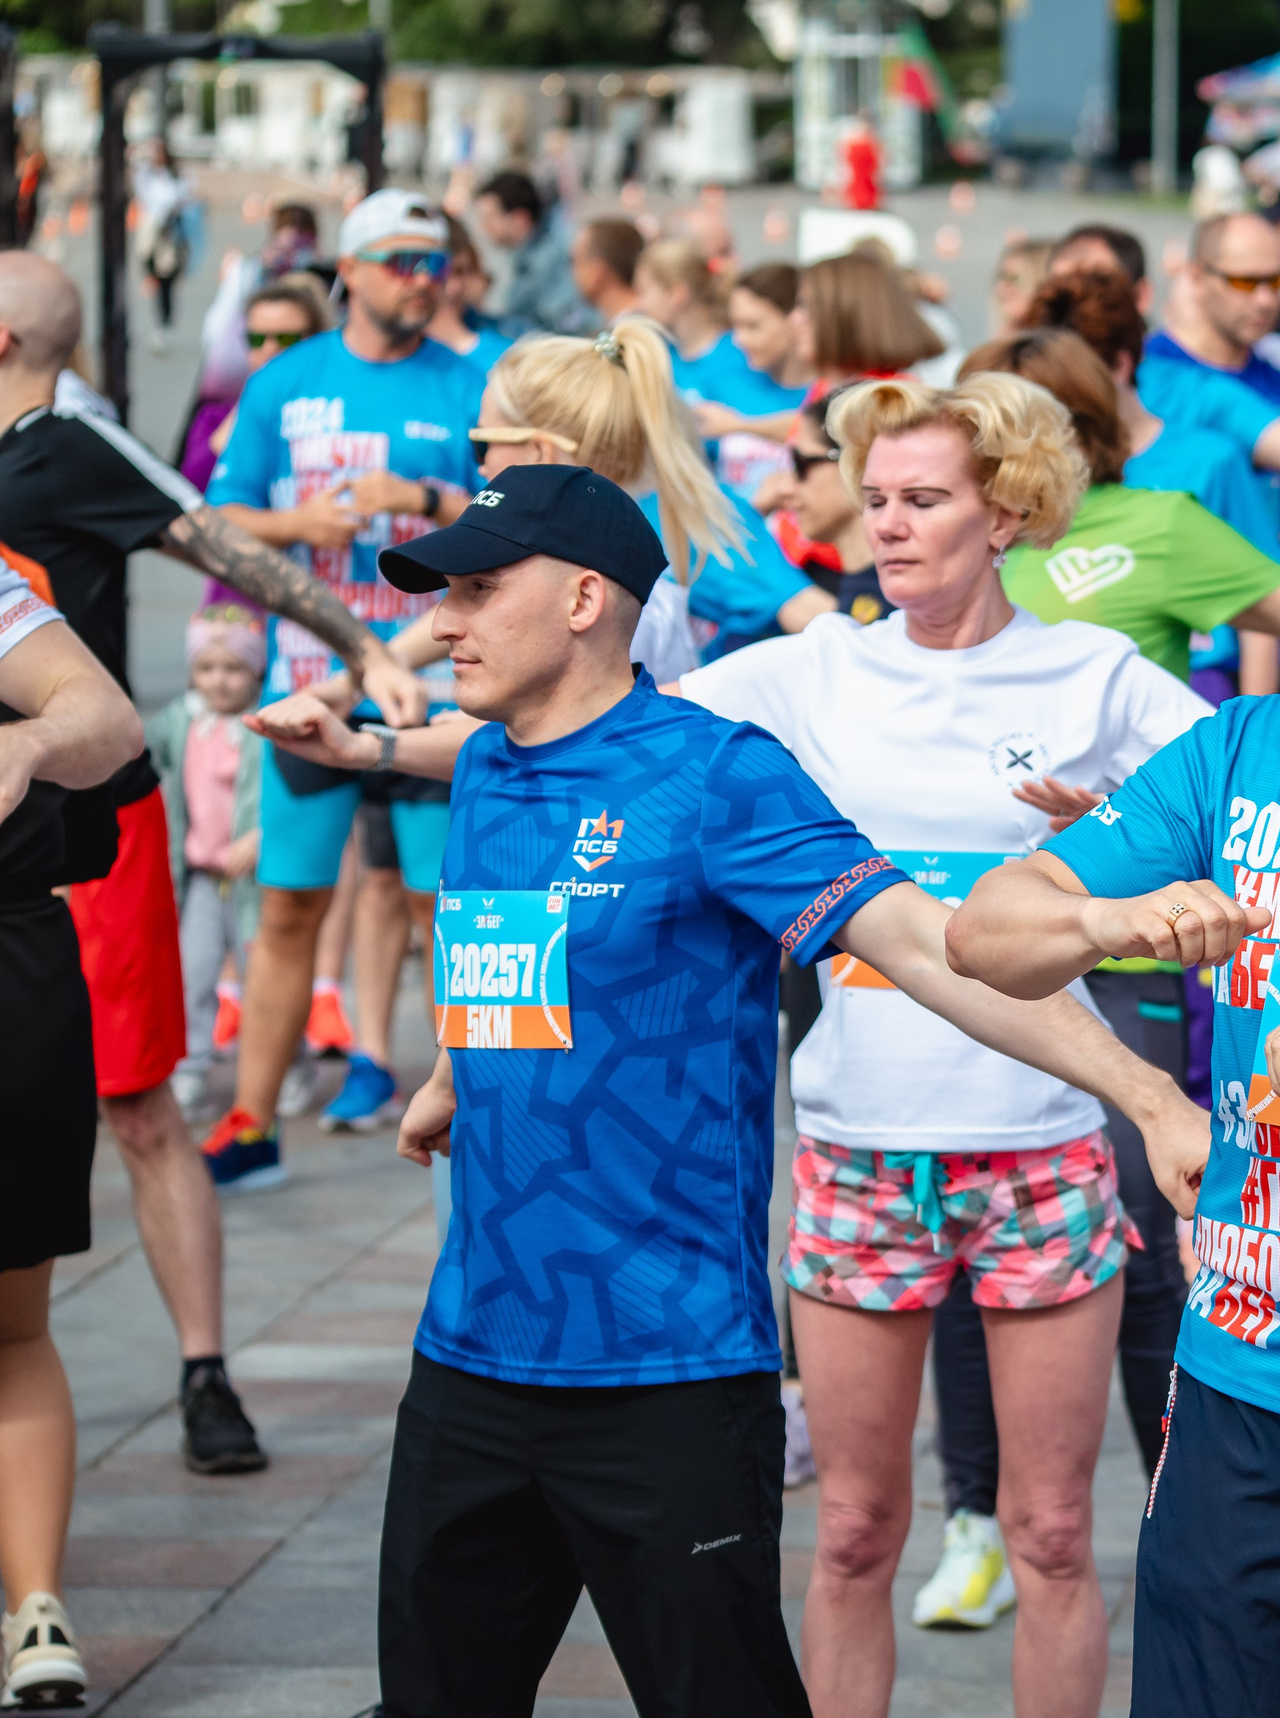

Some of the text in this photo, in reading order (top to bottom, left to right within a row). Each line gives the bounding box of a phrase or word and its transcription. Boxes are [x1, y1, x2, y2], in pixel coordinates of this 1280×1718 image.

[1085, 795, 1122, 826] СБ
[572, 839, 618, 854] ПСБ
[549, 881, 625, 898] СПОРТ
[450, 943, 537, 998] 20257
[702, 1533, 742, 1551] DEMIX
